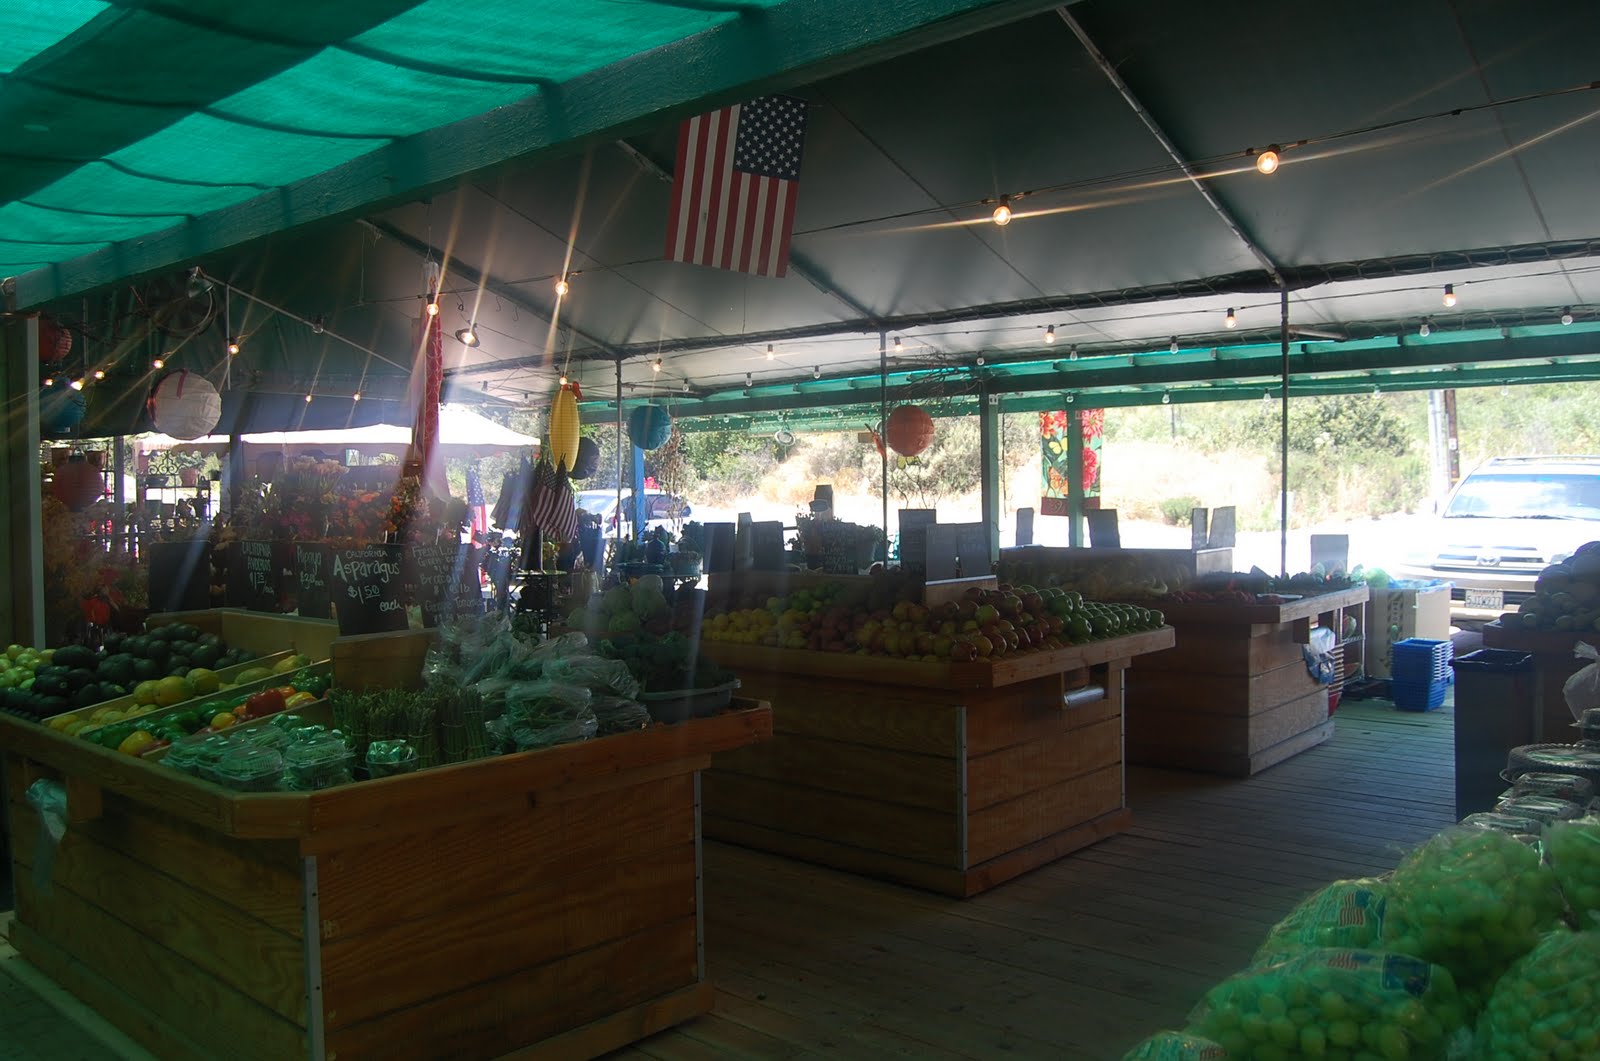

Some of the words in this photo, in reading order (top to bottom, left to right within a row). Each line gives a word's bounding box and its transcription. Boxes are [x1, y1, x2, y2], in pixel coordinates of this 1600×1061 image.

[346, 550, 388, 559] CALIFORNIA
[333, 554, 401, 583] Asparagus
[379, 598, 405, 612] each
